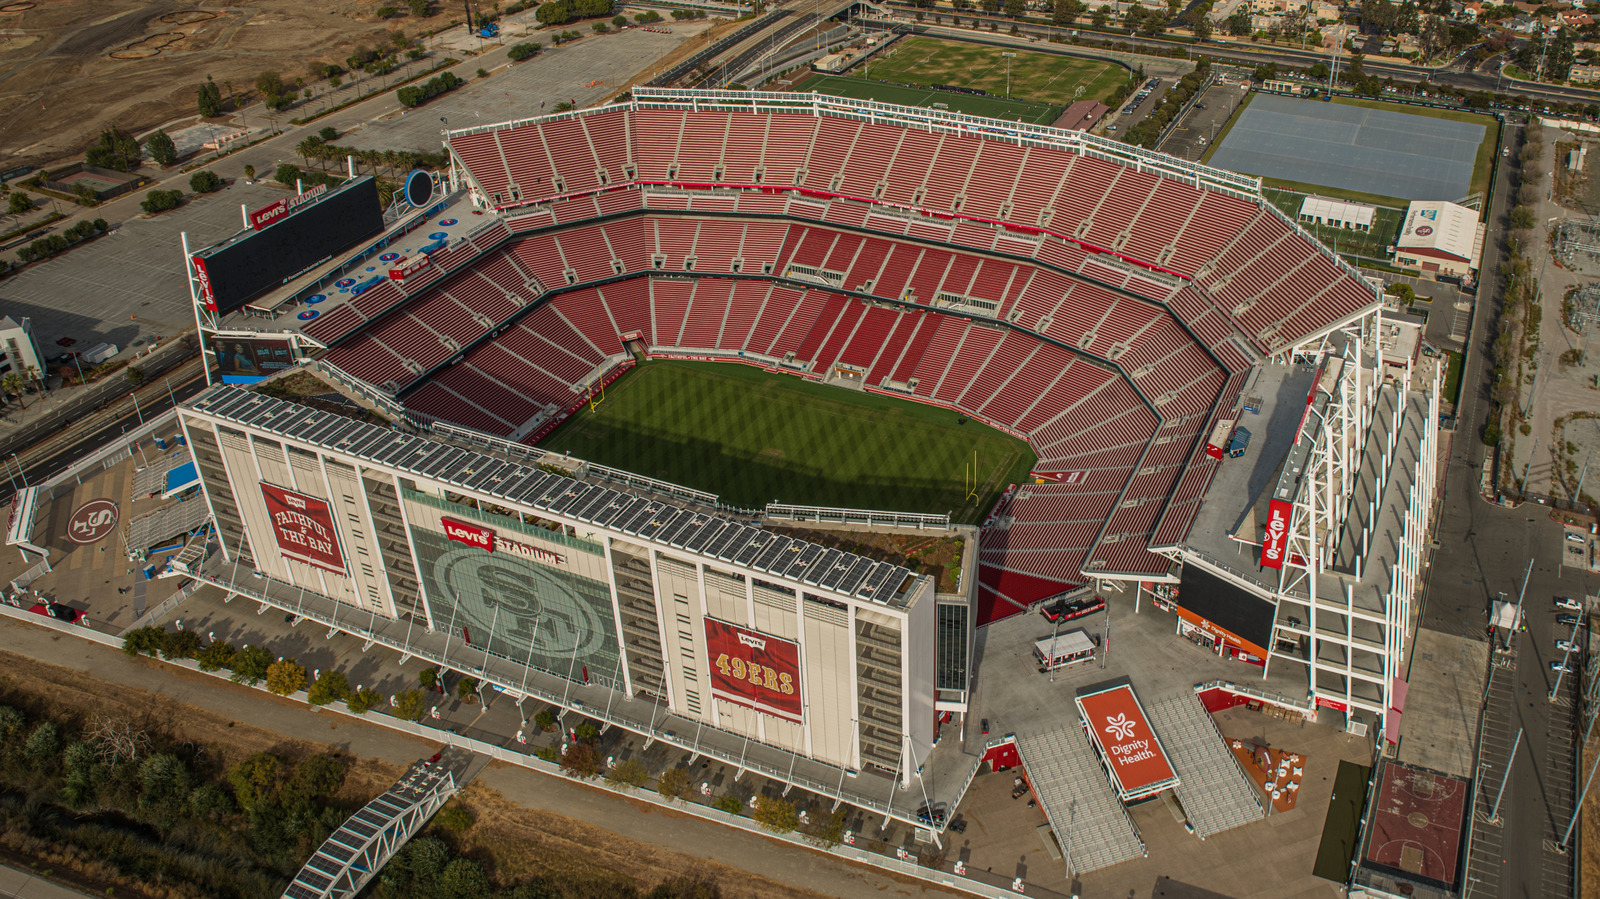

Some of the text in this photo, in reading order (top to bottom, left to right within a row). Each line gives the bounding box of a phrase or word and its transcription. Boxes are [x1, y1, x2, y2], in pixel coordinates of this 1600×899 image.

[288, 184, 327, 209] STADIUM
[275, 510, 331, 542] FAITHFUL
[280, 527, 334, 556] THE BAY
[496, 539, 559, 566] STADIUM
[1210, 625, 1226, 638] Dignity
[1226, 634, 1242, 644] Health
[716, 653, 794, 695] 49ERS
[1110, 739, 1148, 755] Dignity
[1118, 749, 1155, 766] Health
